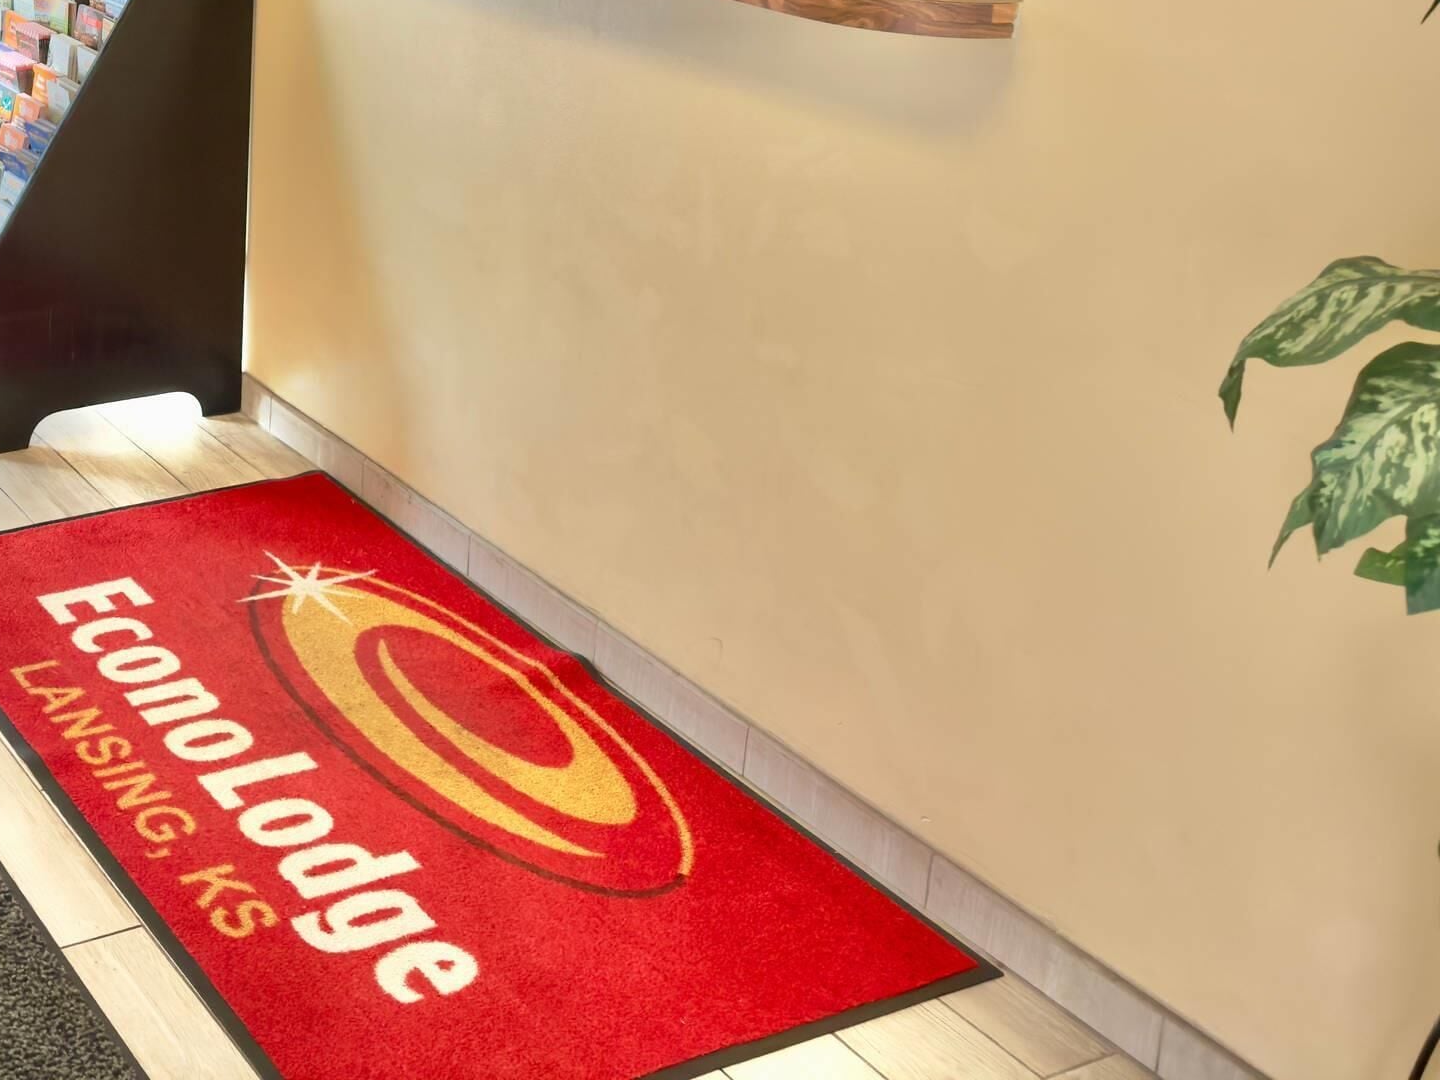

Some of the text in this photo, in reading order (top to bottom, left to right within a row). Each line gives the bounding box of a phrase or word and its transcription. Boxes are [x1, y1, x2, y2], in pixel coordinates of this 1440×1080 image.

[10, 660, 280, 939] LANSING, KS
[36, 576, 479, 1003] EconoLodge
